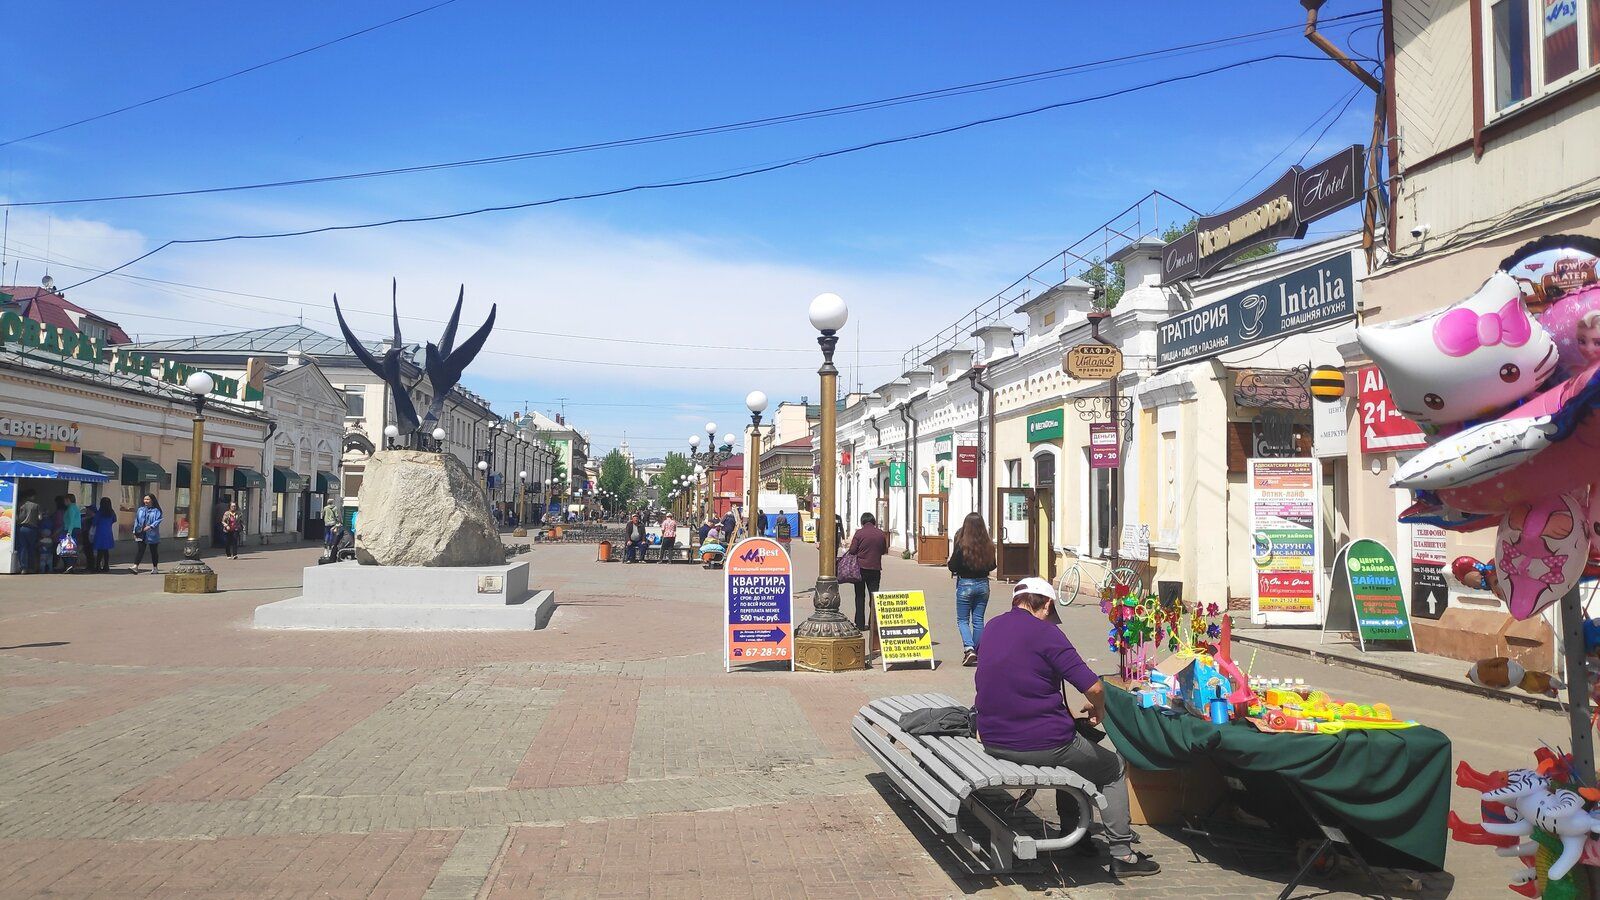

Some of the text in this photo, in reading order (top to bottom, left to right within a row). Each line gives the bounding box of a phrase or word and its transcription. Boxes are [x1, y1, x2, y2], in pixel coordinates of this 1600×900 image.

[1301, 165, 1348, 207] Hotel
[1166, 249, 1194, 274] Отель
[1279, 269, 1345, 317] Intalia
[1161, 304, 1229, 345] ТРАТТОРИЯ
[1281, 301, 1346, 331] ДОМАШНЯЯ КУХНЯ
[1083, 347, 1107, 355] КАФЕ
[1160, 336, 1229, 363] ПИЦЦА ПАСТА ЛАЗАНЬЯ
[0, 417, 81, 443] СВЯЗНОЙ
[758, 547, 779, 557] Best
[1361, 564, 1395, 572] ЗАЙМОВ
[732, 577, 786, 586] КВАРТИРА
[732, 587, 786, 595] В РАССРОЧКУ
[745, 647, 787, 657] 67-28-76
